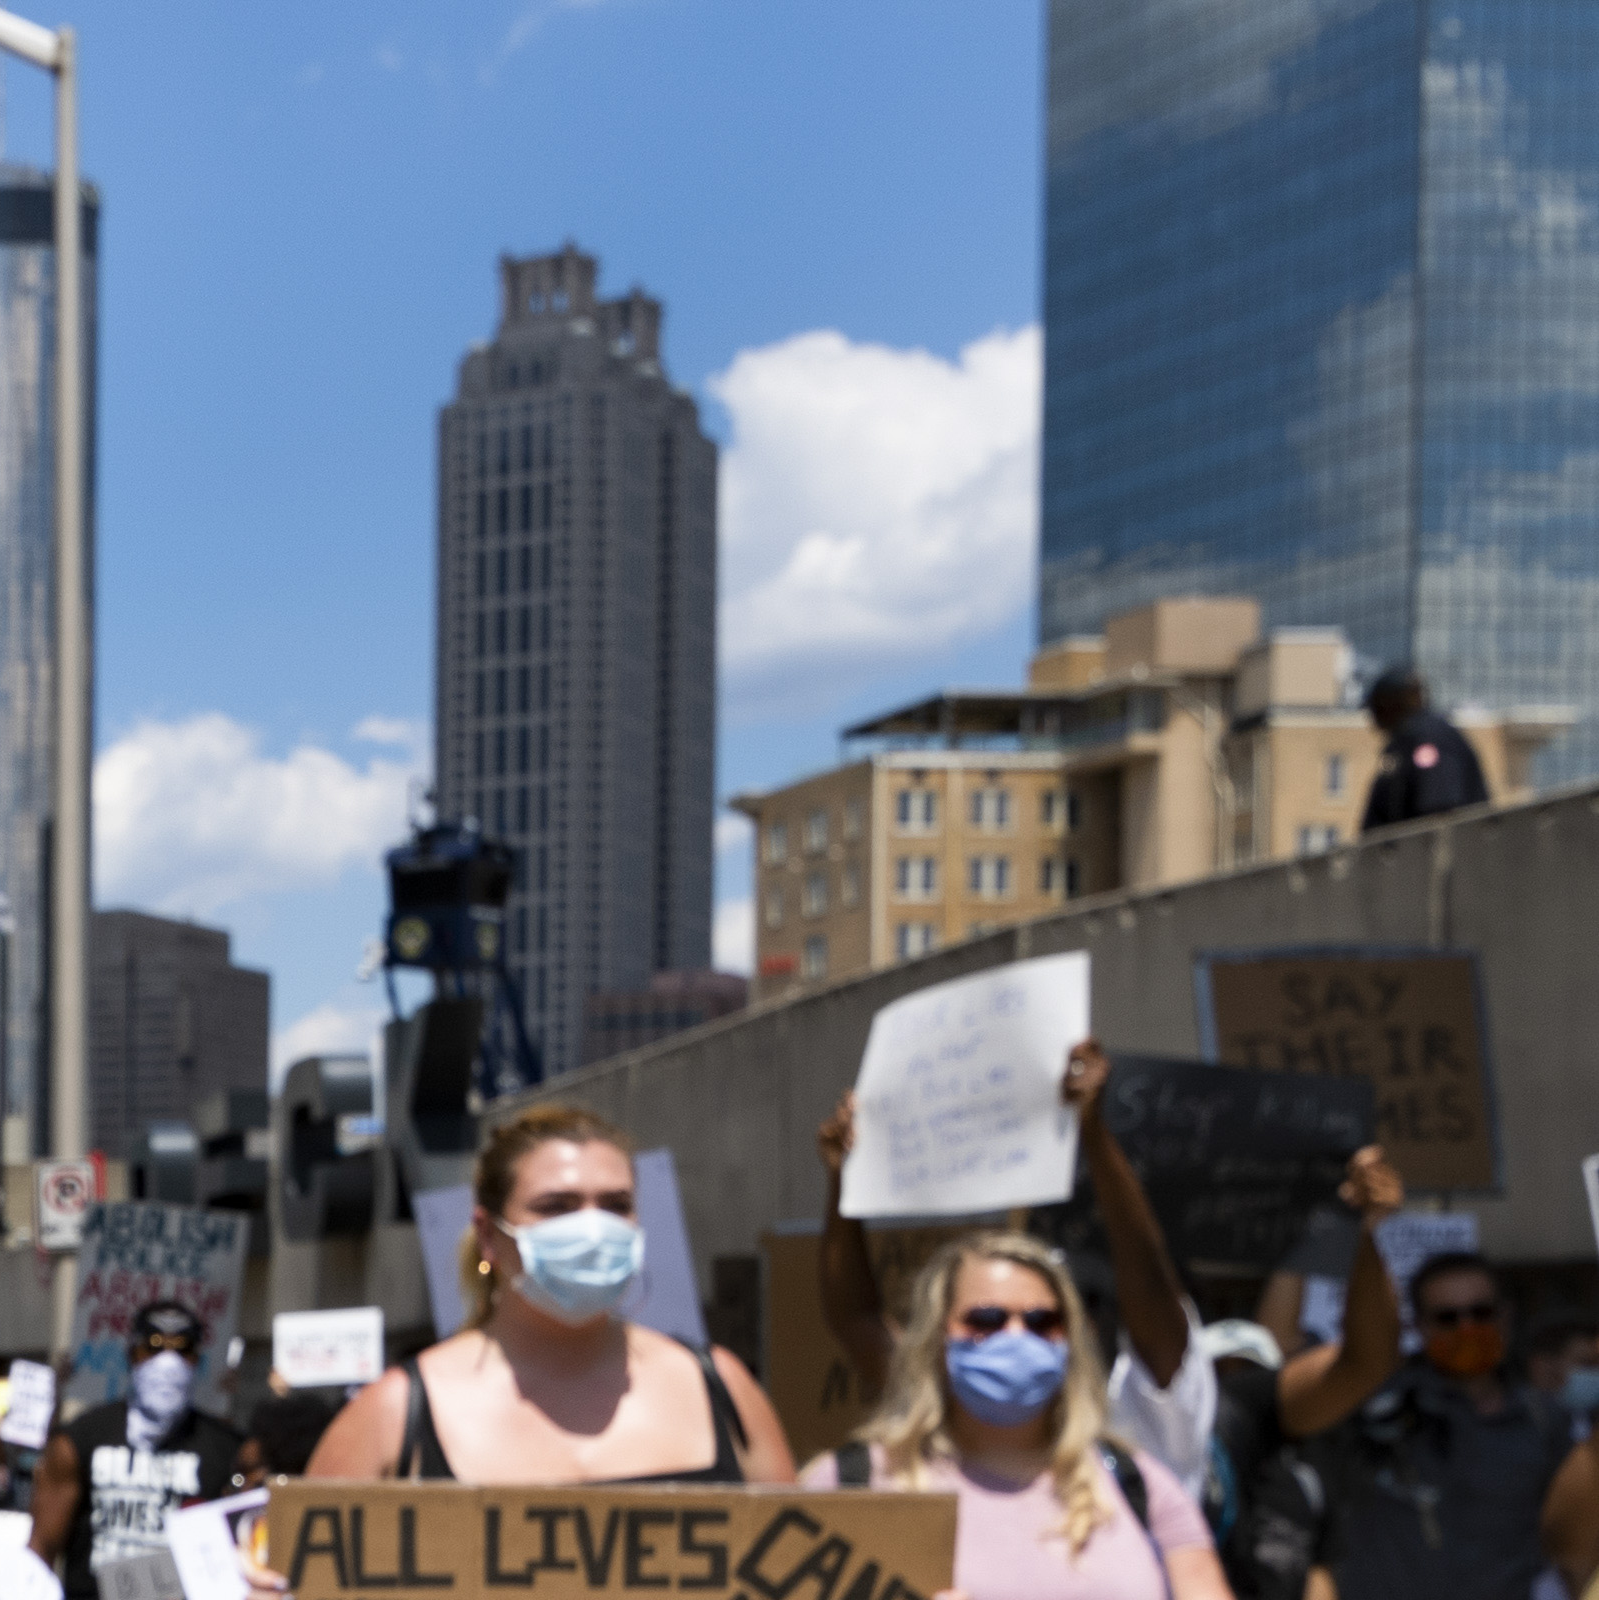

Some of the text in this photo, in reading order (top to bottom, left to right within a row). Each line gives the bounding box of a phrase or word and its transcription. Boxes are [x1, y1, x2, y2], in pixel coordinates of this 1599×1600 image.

[1280, 970, 1402, 1028] SAY
[1231, 1024, 1464, 1077] THEIR
[289, 1508, 455, 1591] ALL
[484, 1508, 732, 1591] LIVES
